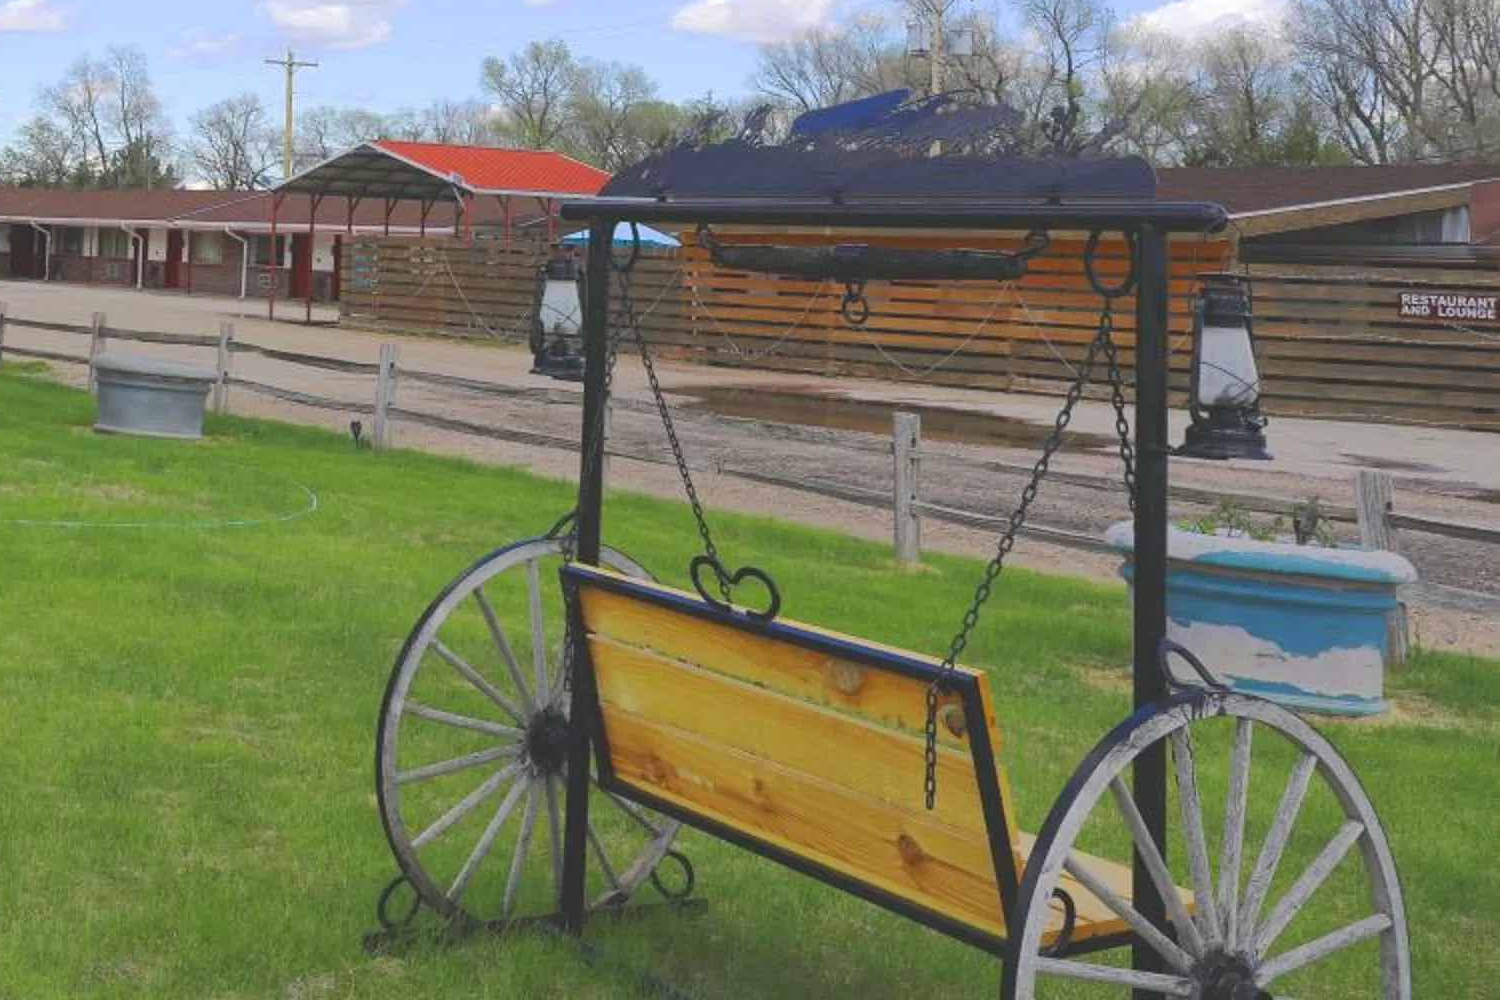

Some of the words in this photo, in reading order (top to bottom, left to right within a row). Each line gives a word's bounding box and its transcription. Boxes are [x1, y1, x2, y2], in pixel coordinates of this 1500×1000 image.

[1401, 293, 1497, 307] RESTAURANT
[1401, 305, 1430, 316] AND
[1438, 305, 1496, 319] LOUNGE
